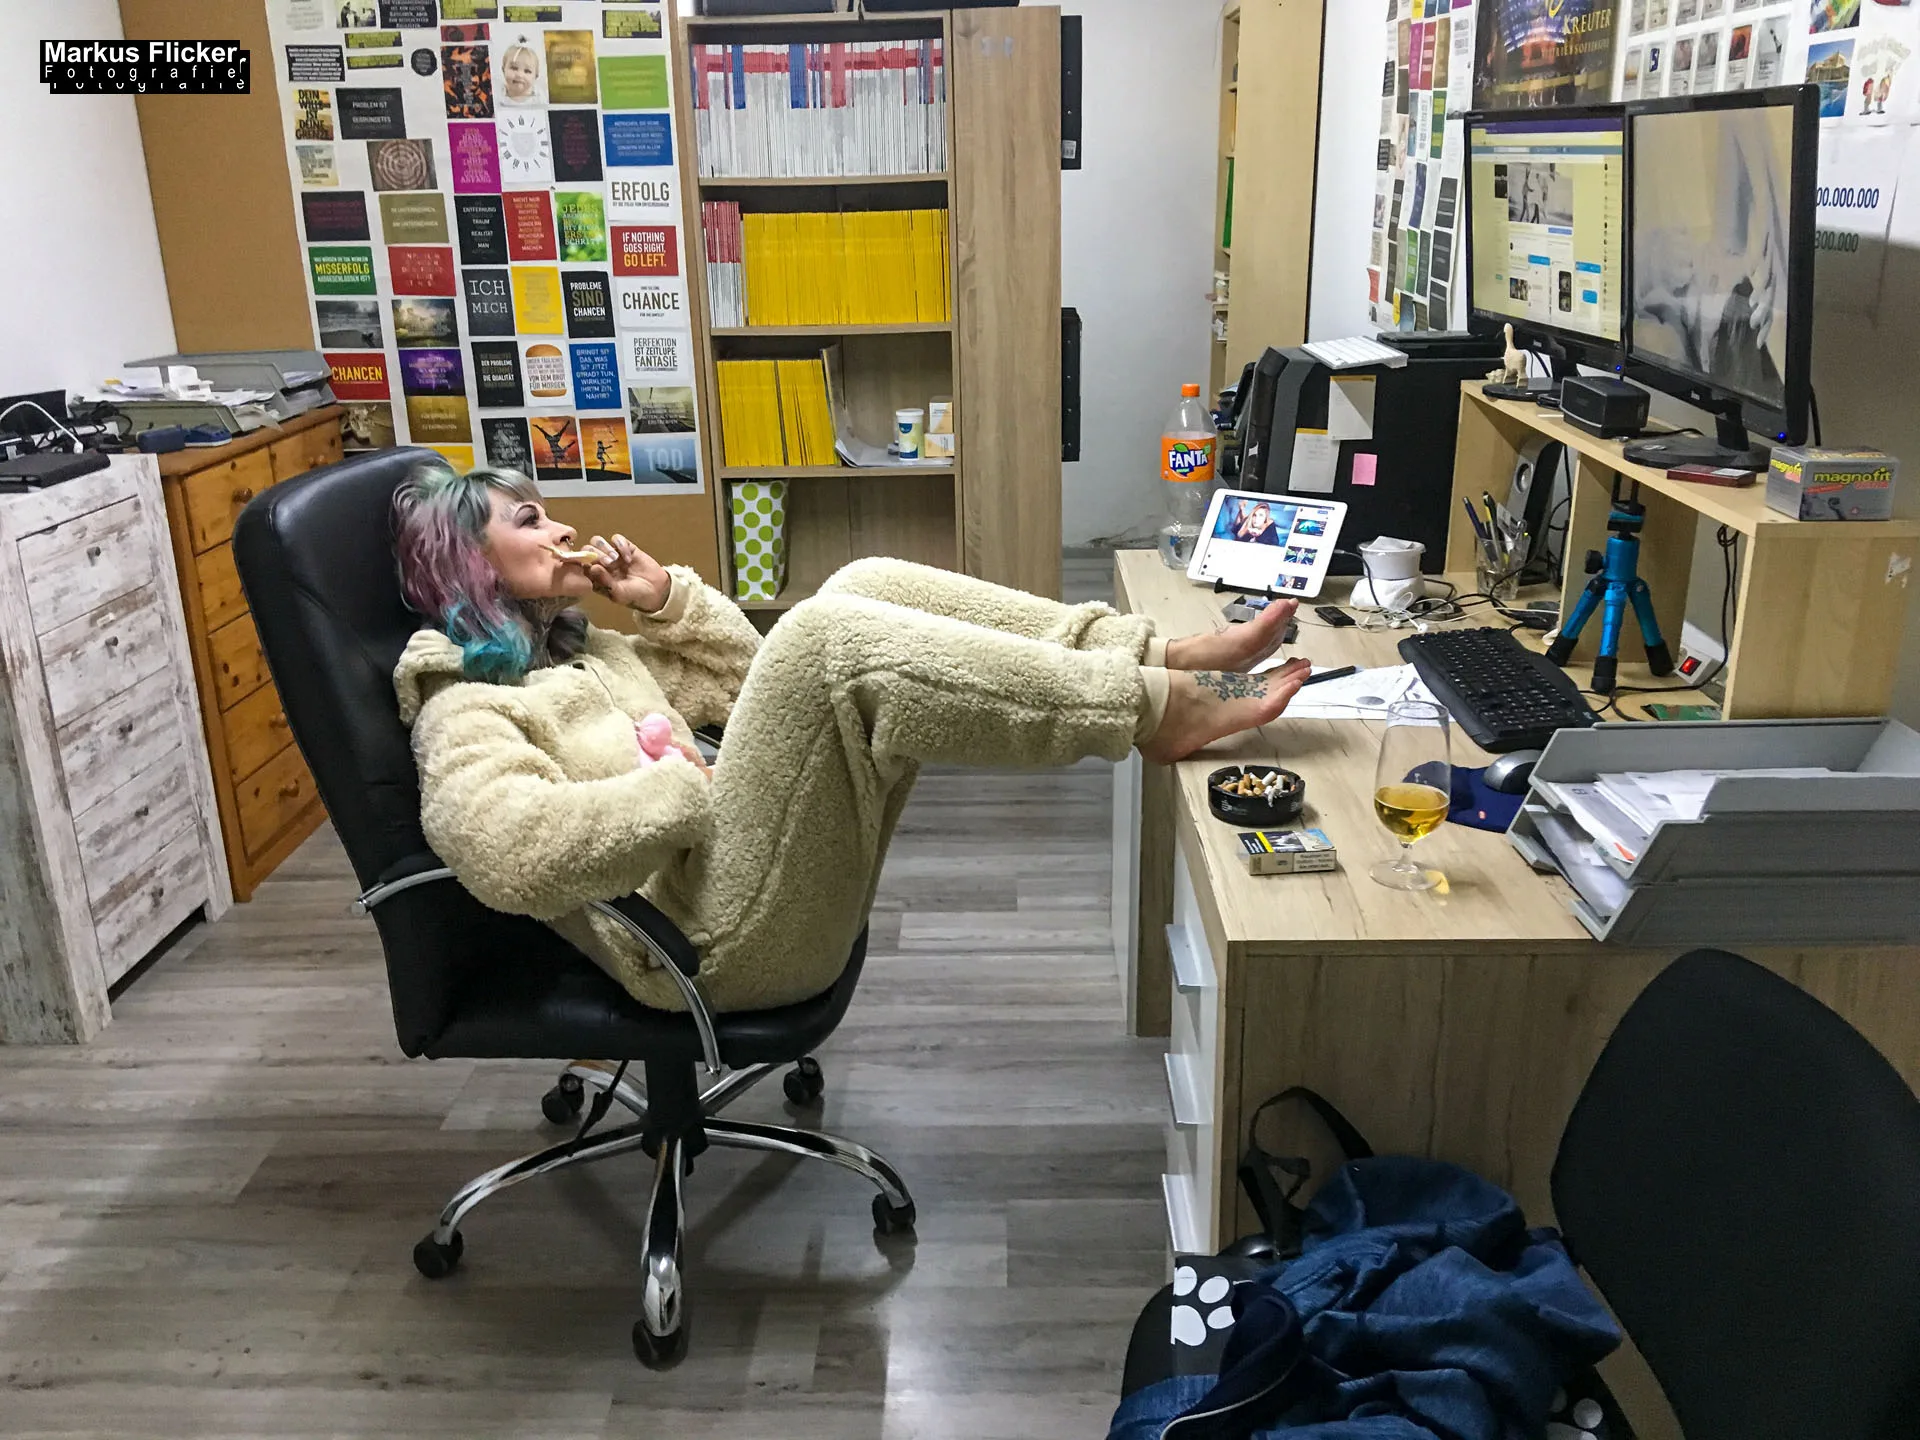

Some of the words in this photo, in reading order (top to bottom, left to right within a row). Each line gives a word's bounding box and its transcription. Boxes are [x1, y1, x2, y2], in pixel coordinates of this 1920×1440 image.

[1563, 9, 1611, 35] KREUTER
[298, 90, 319, 100] DEIN
[611, 182, 670, 201] ERFOLG
[622, 232, 630, 243] IF
[631, 231, 665, 243] NOTHING
[623, 243, 643, 253] GOES
[624, 253, 638, 267] GO
[640, 253, 667, 268] LEFT.
[315, 263, 370, 275] MISSERFOLG
[469, 280, 506, 296] ICH
[570, 282, 602, 291] PROBLEME
[572, 291, 604, 307] SIND
[623, 292, 680, 310] CHANCE
[472, 302, 508, 314] MICH
[573, 307, 606, 316] CHANCEN
[633, 338, 677, 347] PERFEKTION
[634, 347, 645, 355] IST
[646, 347, 676, 355] ZEITLUPE
[635, 355, 678, 367] FANTASIE
[332, 367, 383, 381] CHANCEN
[644, 448, 683, 471] TOD
[1168, 450, 1208, 468] FANTA
[1814, 466, 1891, 485] magnofit
